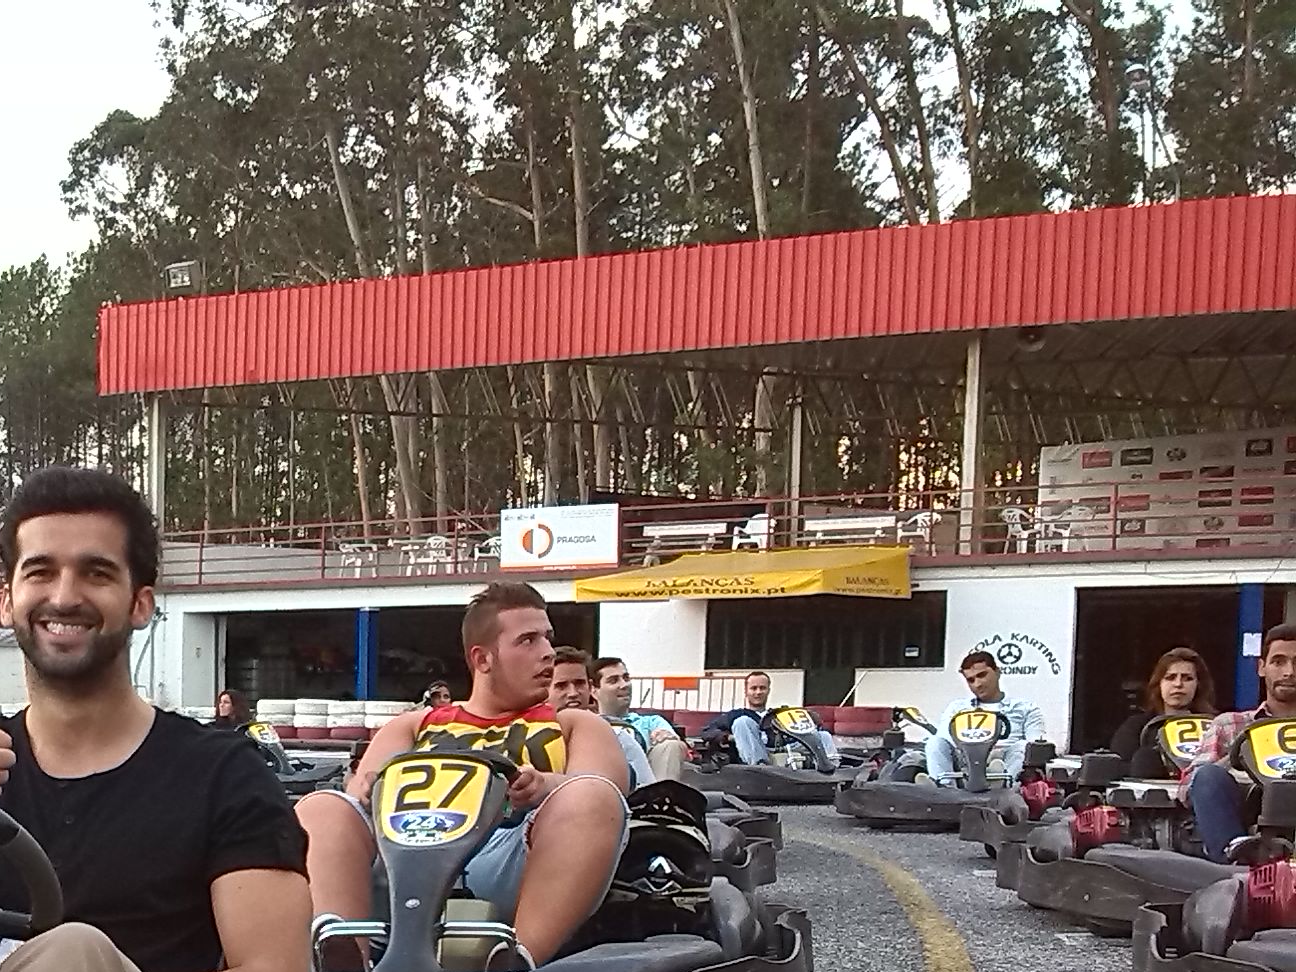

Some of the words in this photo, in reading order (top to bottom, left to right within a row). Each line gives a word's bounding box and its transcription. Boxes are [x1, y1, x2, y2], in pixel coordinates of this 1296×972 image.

[1010, 633, 1061, 675] KARTING
[967, 714, 989, 730] 17
[1278, 725, 1296, 754] 6
[394, 763, 477, 812] 27
